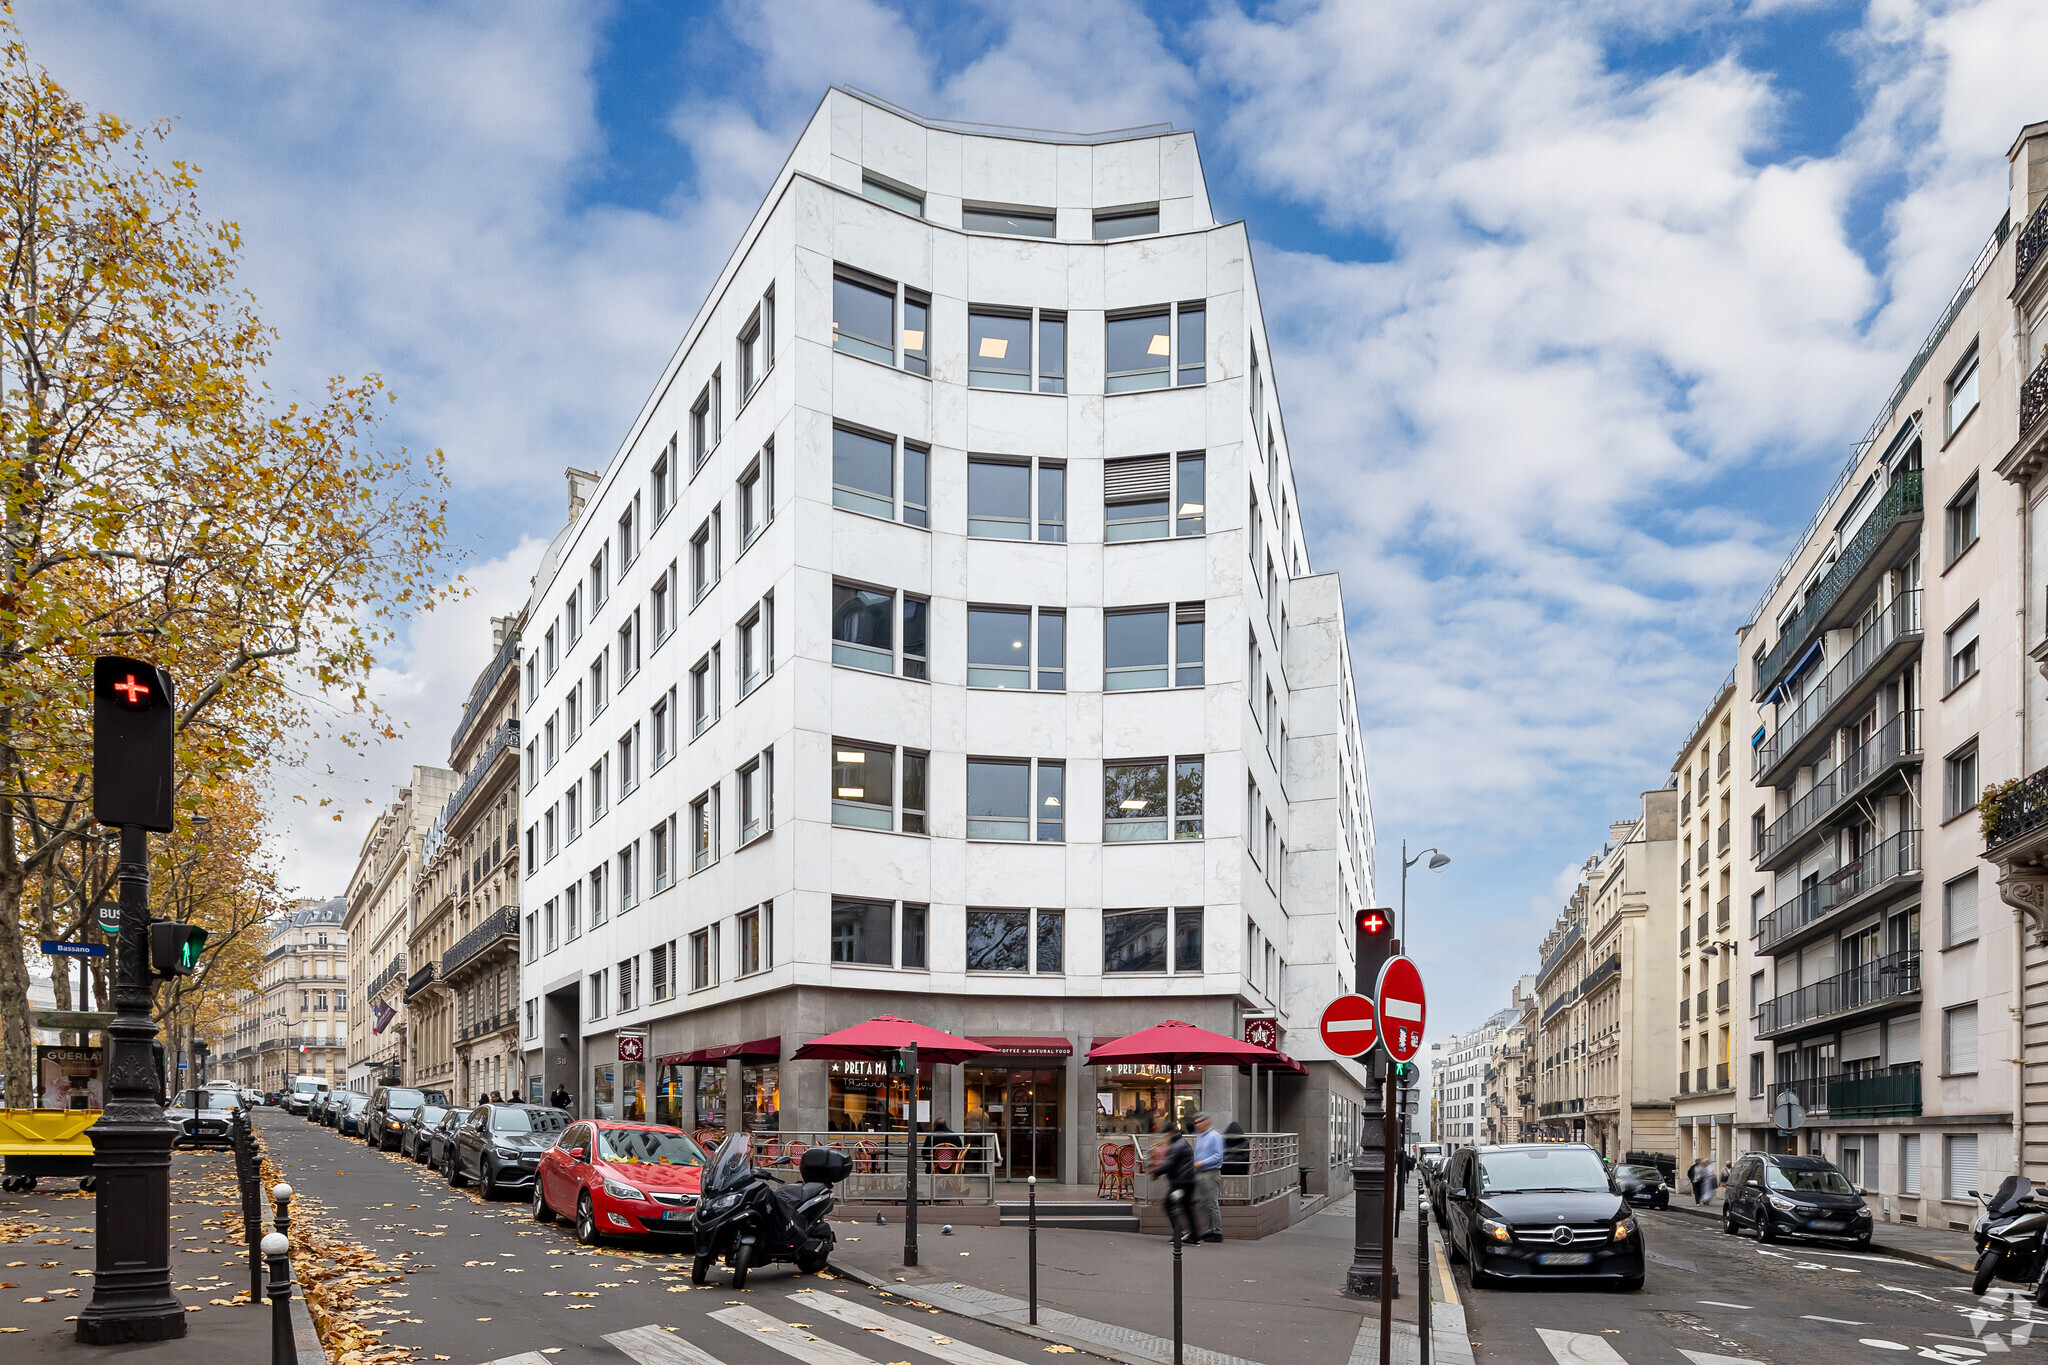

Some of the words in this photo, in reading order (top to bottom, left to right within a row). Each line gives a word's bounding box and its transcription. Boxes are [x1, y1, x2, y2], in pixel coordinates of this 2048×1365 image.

[57, 944, 90, 953] Bassano
[47, 1051, 102, 1061] GUERLAI
[556, 1057, 567, 1065] 58
[844, 1061, 865, 1075] PRET
[866, 1062, 873, 1075] A
